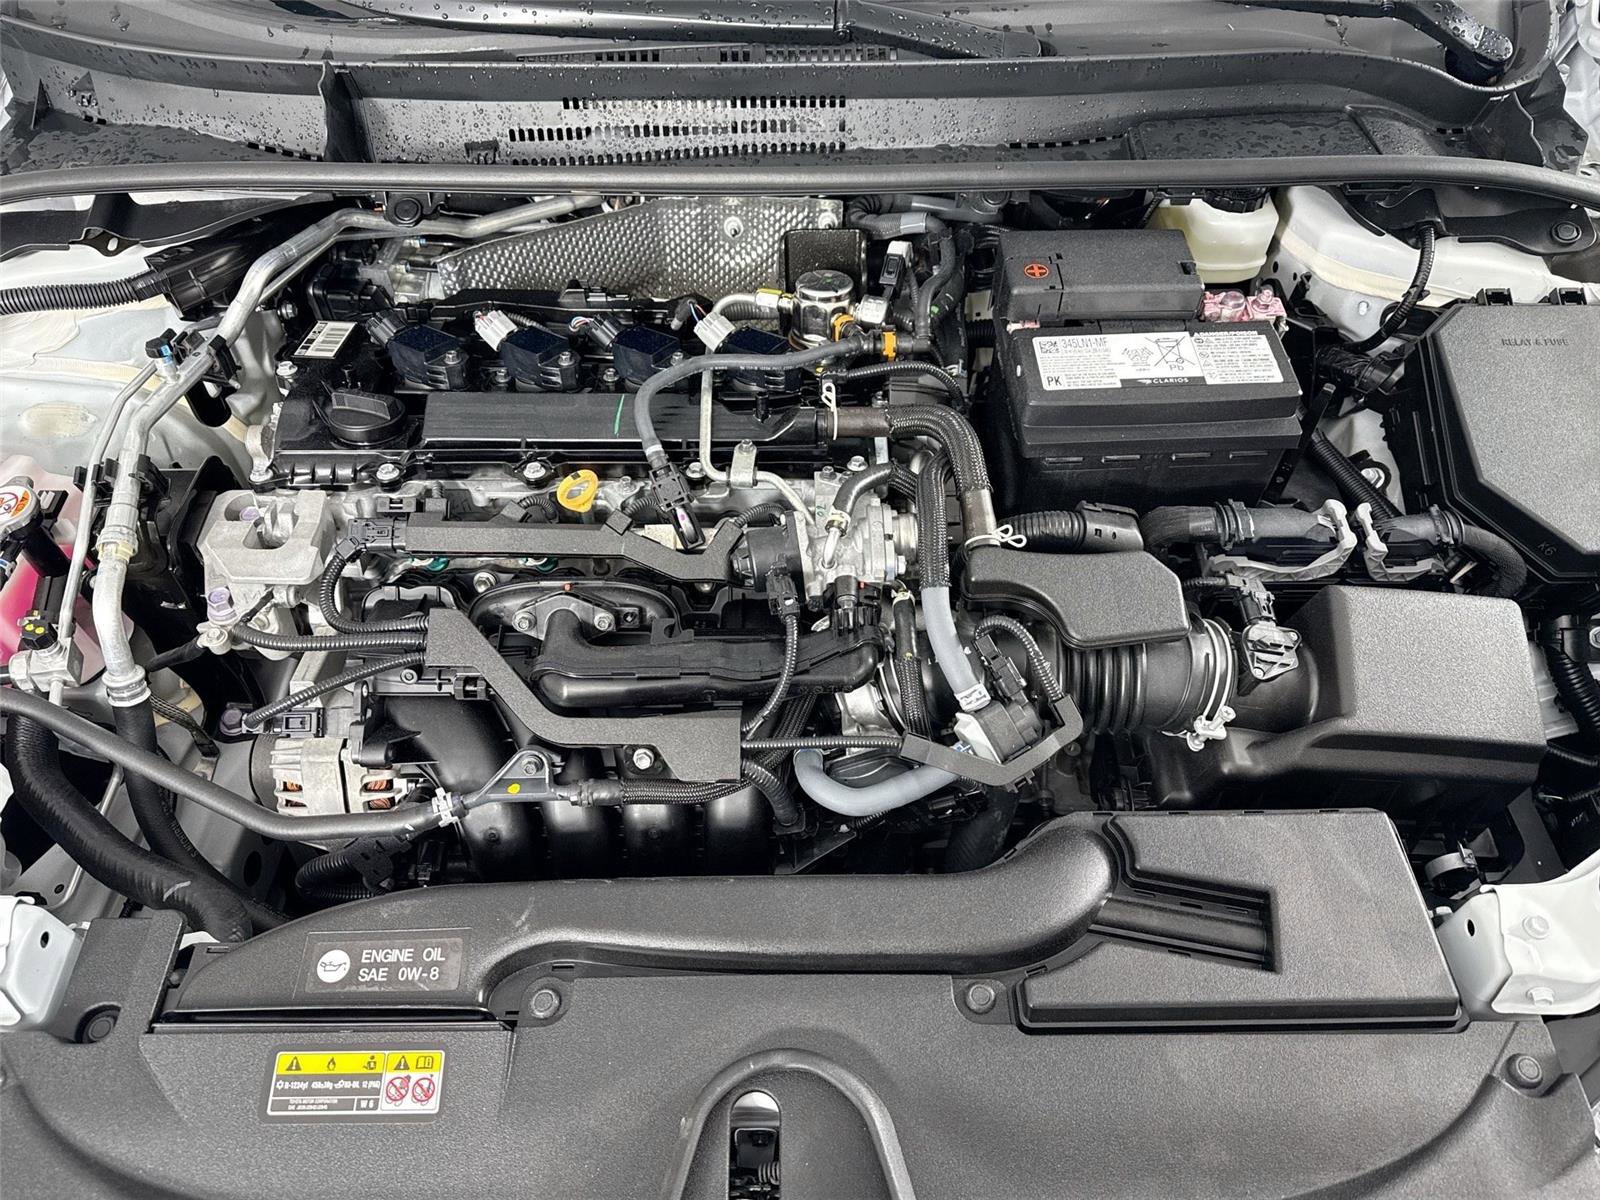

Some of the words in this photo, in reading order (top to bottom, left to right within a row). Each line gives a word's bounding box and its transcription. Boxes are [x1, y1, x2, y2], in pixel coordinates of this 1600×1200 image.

[1047, 376, 1063, 387] PK
[361, 949, 415, 963] ENGINE
[422, 947, 446, 962] OIL
[358, 968, 388, 982] SAE
[398, 967, 440, 981] 0W-8
